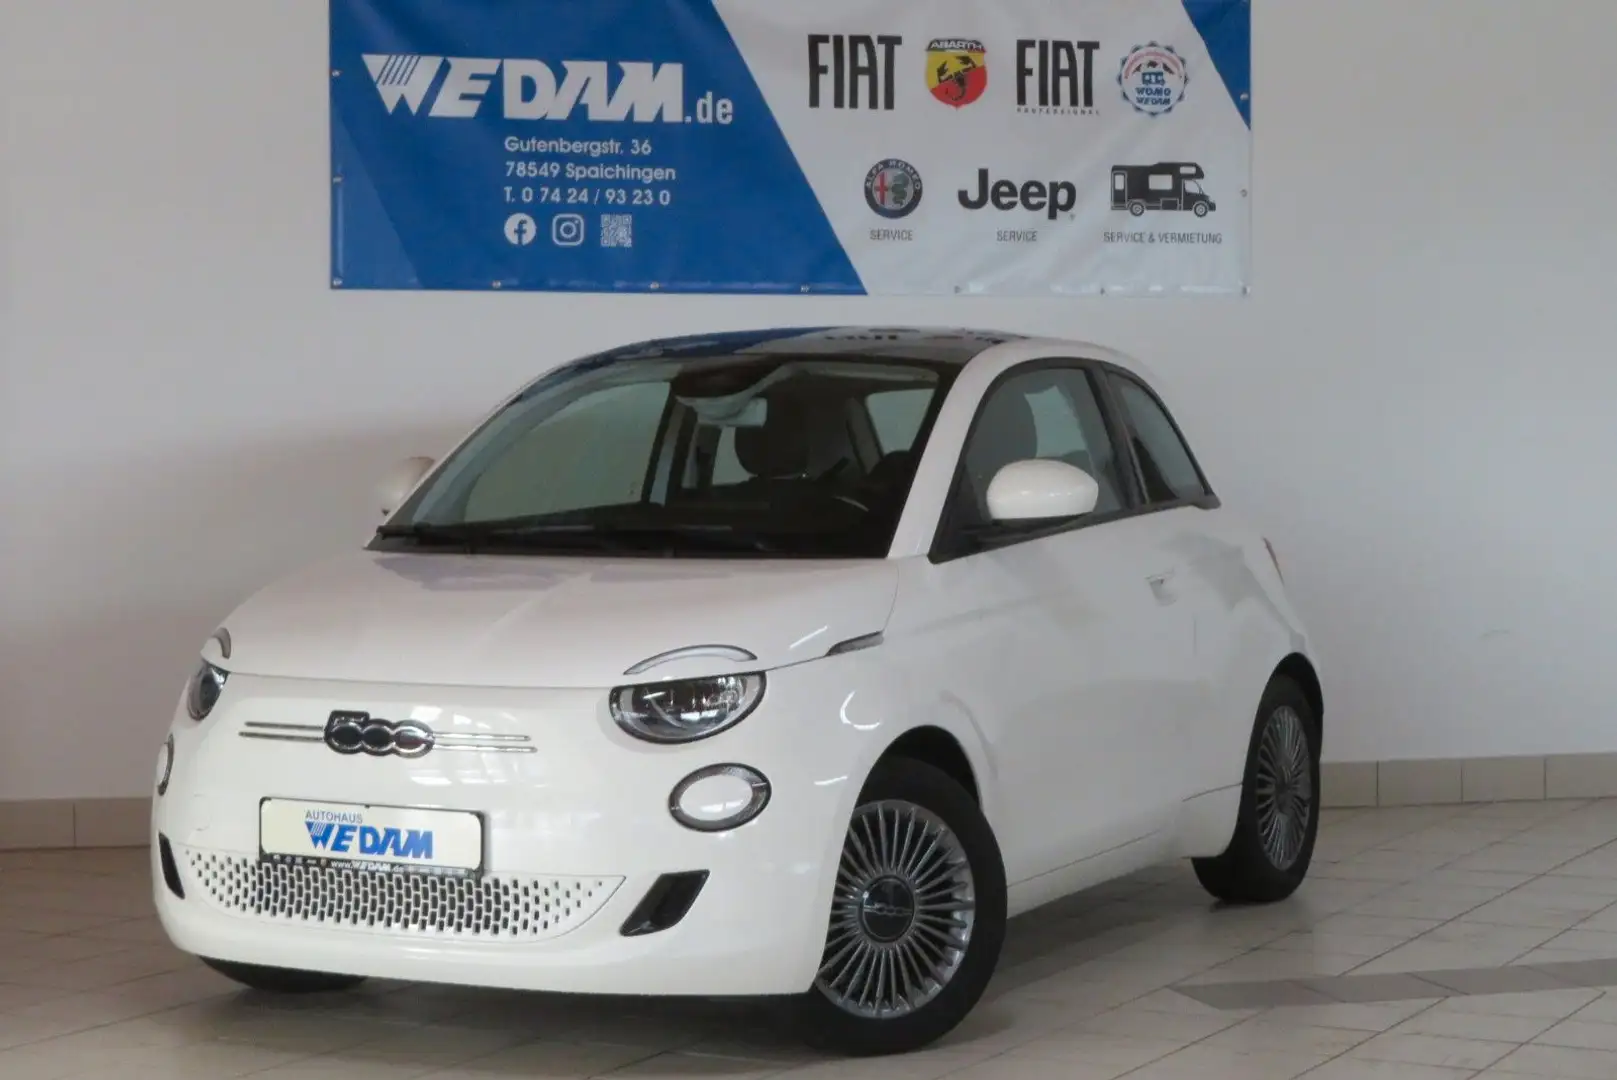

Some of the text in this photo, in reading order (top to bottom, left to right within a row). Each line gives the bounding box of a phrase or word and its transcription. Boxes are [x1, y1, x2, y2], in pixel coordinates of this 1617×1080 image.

[929, 39, 983, 50] ABARTH
[808, 34, 902, 110] FIAT
[1016, 39, 1100, 107] FIAT
[504, 136, 652, 157] Gutenbergstr. 36
[505, 161, 676, 184] 78549 Spaichingen
[503, 187, 671, 205] T. 0 74 24 / 93 23 0
[957, 168, 1077, 220] Jeep
[870, 229, 913, 241] SERVICE
[996, 230, 1038, 242] SERVICE
[1103, 231, 1223, 244] SERVICE & VERMIETUNG
[324, 709, 436, 760] 500
[305, 810, 363, 824] AUTOHAUS
[304, 821, 433, 859] WEDAM
